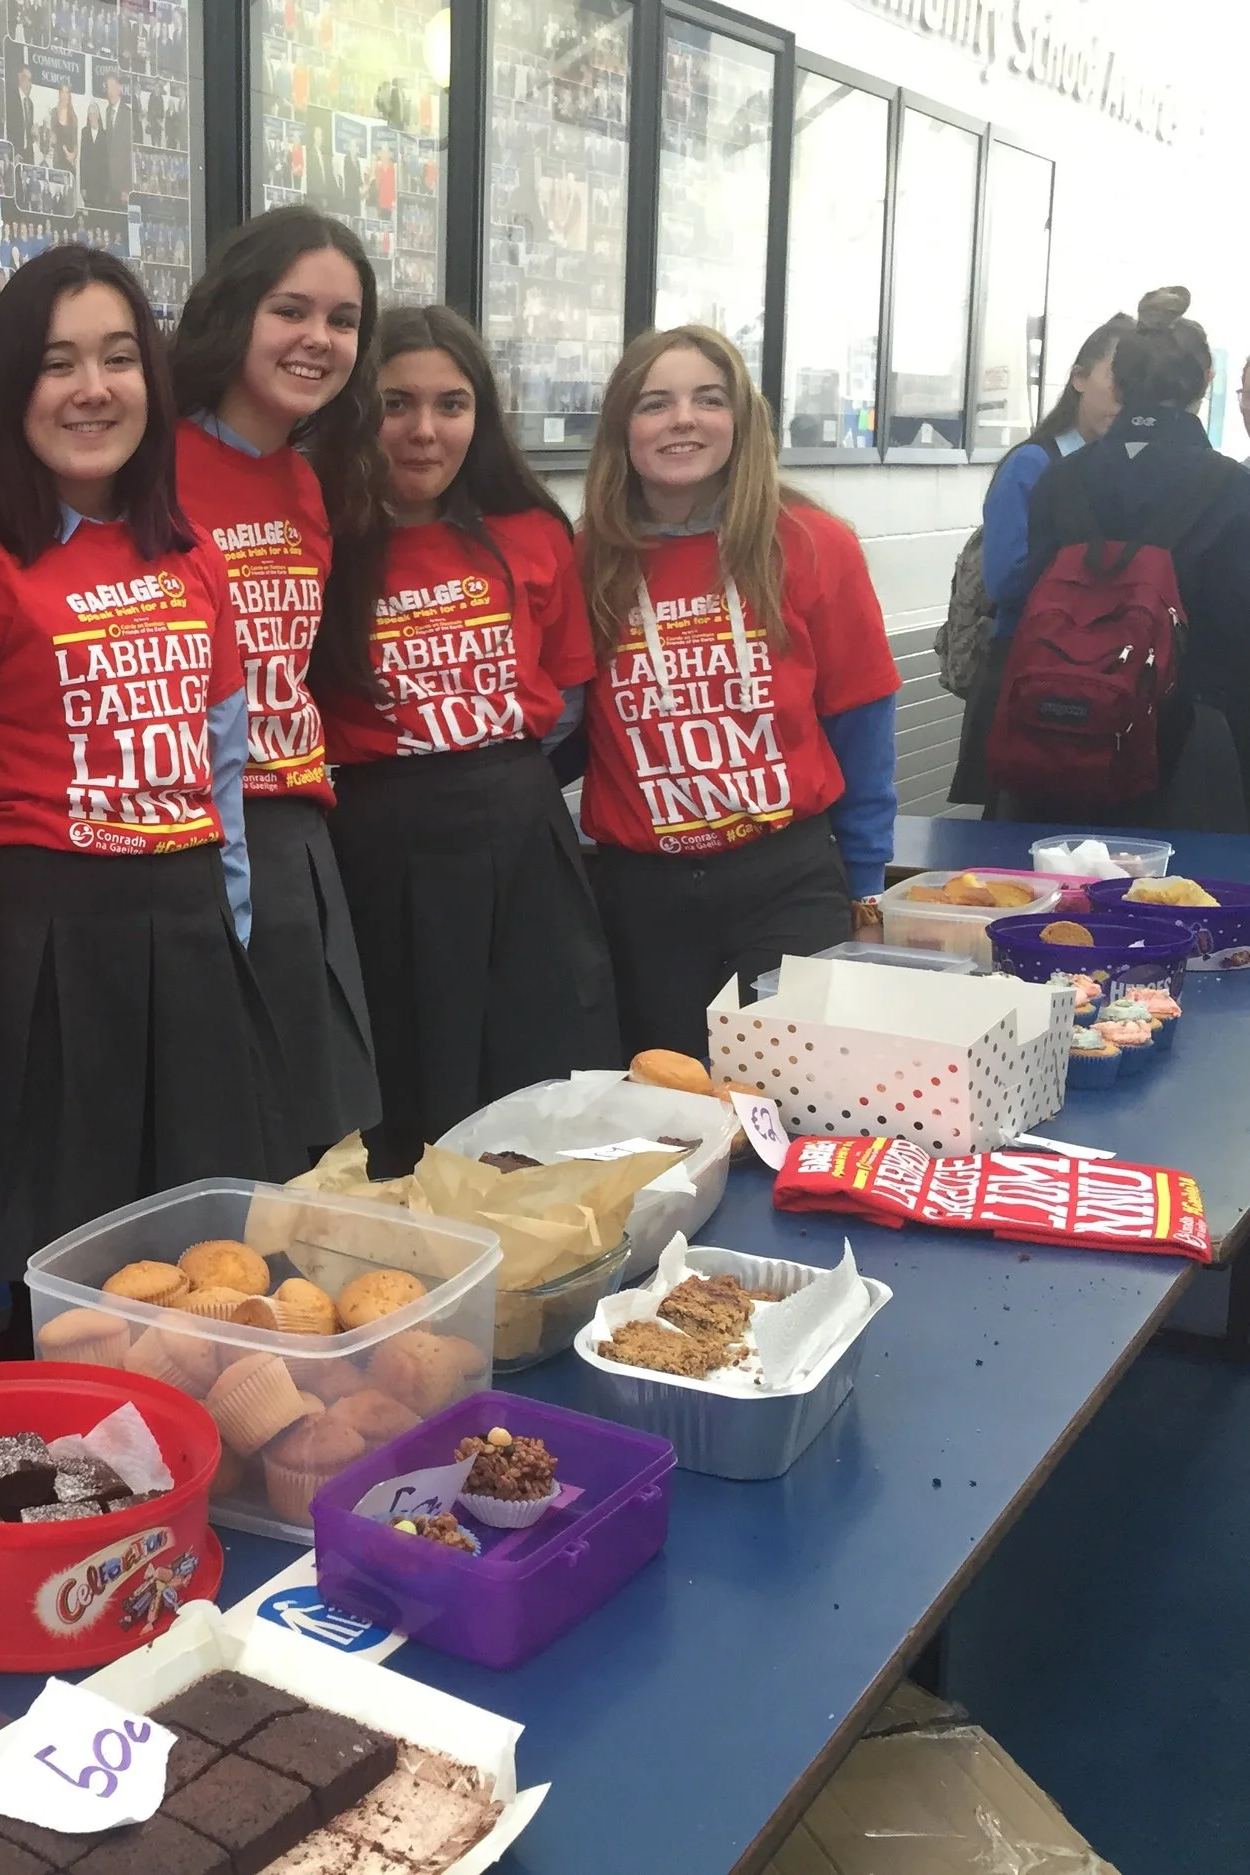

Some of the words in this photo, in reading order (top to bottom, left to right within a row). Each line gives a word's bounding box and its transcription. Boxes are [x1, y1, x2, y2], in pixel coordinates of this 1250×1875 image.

[212, 520, 286, 551] GAEILGE
[224, 551, 247, 562] peak
[248, 547, 267, 558] Irish
[269, 546, 281, 555] for
[66, 575, 164, 614] GAEILGE
[163, 578, 181, 591] 24
[228, 578, 322, 614] ABHAIR
[468, 581, 483, 592] 24
[77, 610, 114, 623] Speak
[115, 605, 140, 617] Irish
[140, 601, 157, 612] for
[169, 597, 187, 608] day
[376, 614, 410, 626] Speak
[413, 608, 437, 619] Irish
[440, 606, 456, 615] for
[470, 597, 490, 607] day
[666, 619, 691, 630] Irish
[693, 616, 711, 626] for
[714, 615, 722, 623] a
[234, 615, 321, 653] AEILGE
[380, 625, 516, 673] ABHAIR
[55, 633, 213, 687] LABHAIR
[610, 641, 772, 688] LABHAR
[62, 674, 209, 727] GAEILGE
[68, 719, 211, 789] LIOM
[626, 713, 783, 777] LIOM
[243, 773, 277, 782] onradh
[250, 782, 278, 791] Gaeilge
[639, 762, 791, 826] INNIU
[95, 841, 107, 850] na
[96, 829, 146, 848] Conradh
[870, 1139, 931, 1210] LABHAIR
[922, 1153, 982, 1220] GAEILGE
[980, 1151, 1070, 1230] LIOM
[1073, 1159, 1155, 1239] NNIU
[33, 1719, 151, 1799] 50c
